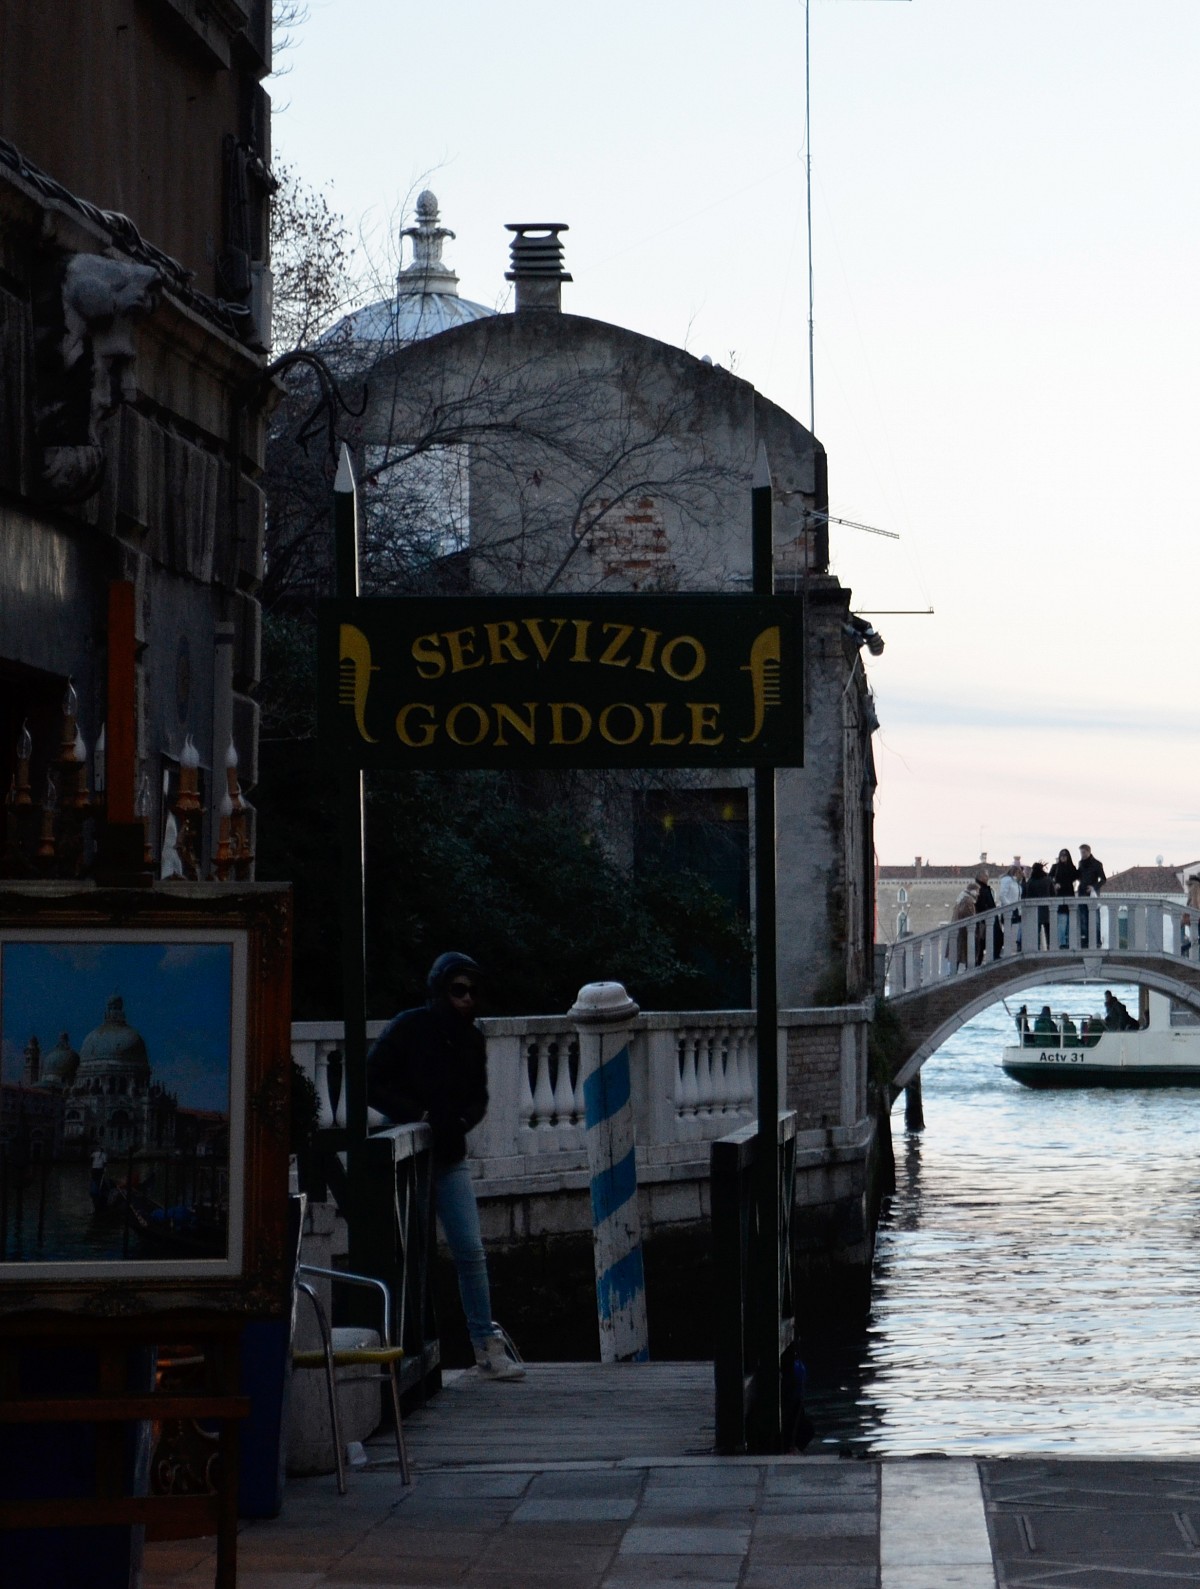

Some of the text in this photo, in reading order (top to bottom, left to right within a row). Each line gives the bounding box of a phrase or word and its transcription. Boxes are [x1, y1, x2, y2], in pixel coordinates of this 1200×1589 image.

[410, 617, 707, 682] SERVIZIO
[395, 701, 725, 747] GONDOLE
[1039, 1051, 1085, 1063] Actv 31
